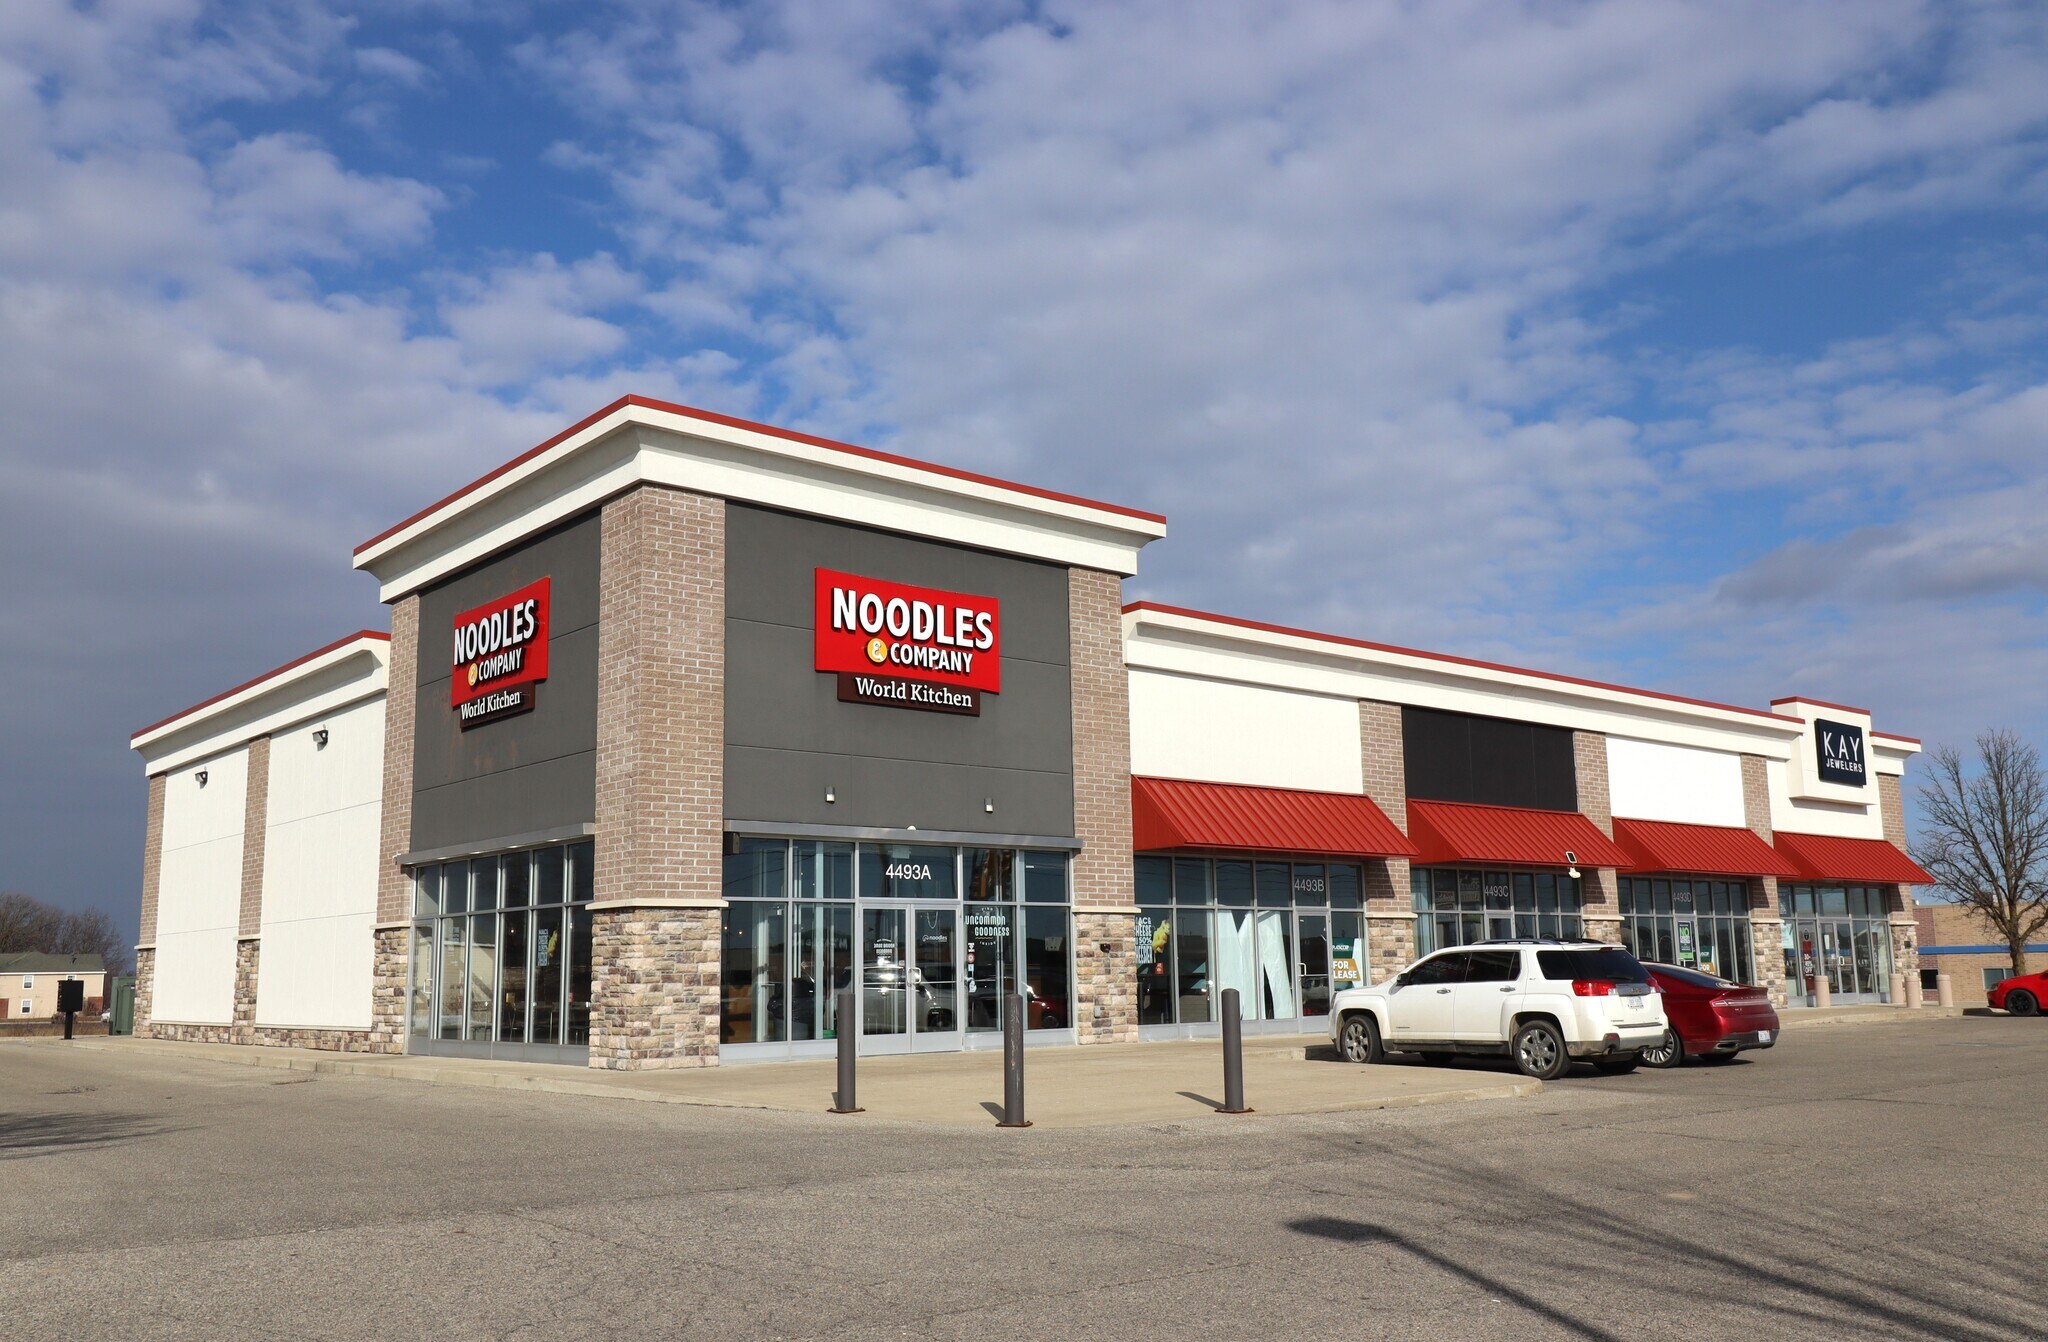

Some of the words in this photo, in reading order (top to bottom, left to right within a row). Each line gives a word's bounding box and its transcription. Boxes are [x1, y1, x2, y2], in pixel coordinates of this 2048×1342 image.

[833, 587, 994, 650] NOODLES
[454, 599, 535, 666] NOODLES
[890, 642, 973, 674] COMPANY
[478, 648, 523, 682] COMPANY
[855, 677, 907, 701] World
[910, 684, 973, 708] Kitchen
[460, 699, 486, 720] World
[486, 690, 521, 713] Kitchen
[1823, 731, 1860, 762] KAY
[1826, 758, 1863, 773] JEWELERS
[885, 863, 931, 880] 4493A
[1295, 880, 1324, 892] 4493B
[1484, 885, 1509, 897] 4493C
[1673, 892, 1692, 902] 4493D
[965, 915, 1006, 926] UNCOMMON
[975, 927, 1010, 936] GOODNESS
[1136, 925, 1152, 937] HEESE
[1679, 927, 1689, 936] NO
[1332, 961, 1349, 970] FOR
[1333, 970, 1358, 979] LEASE
